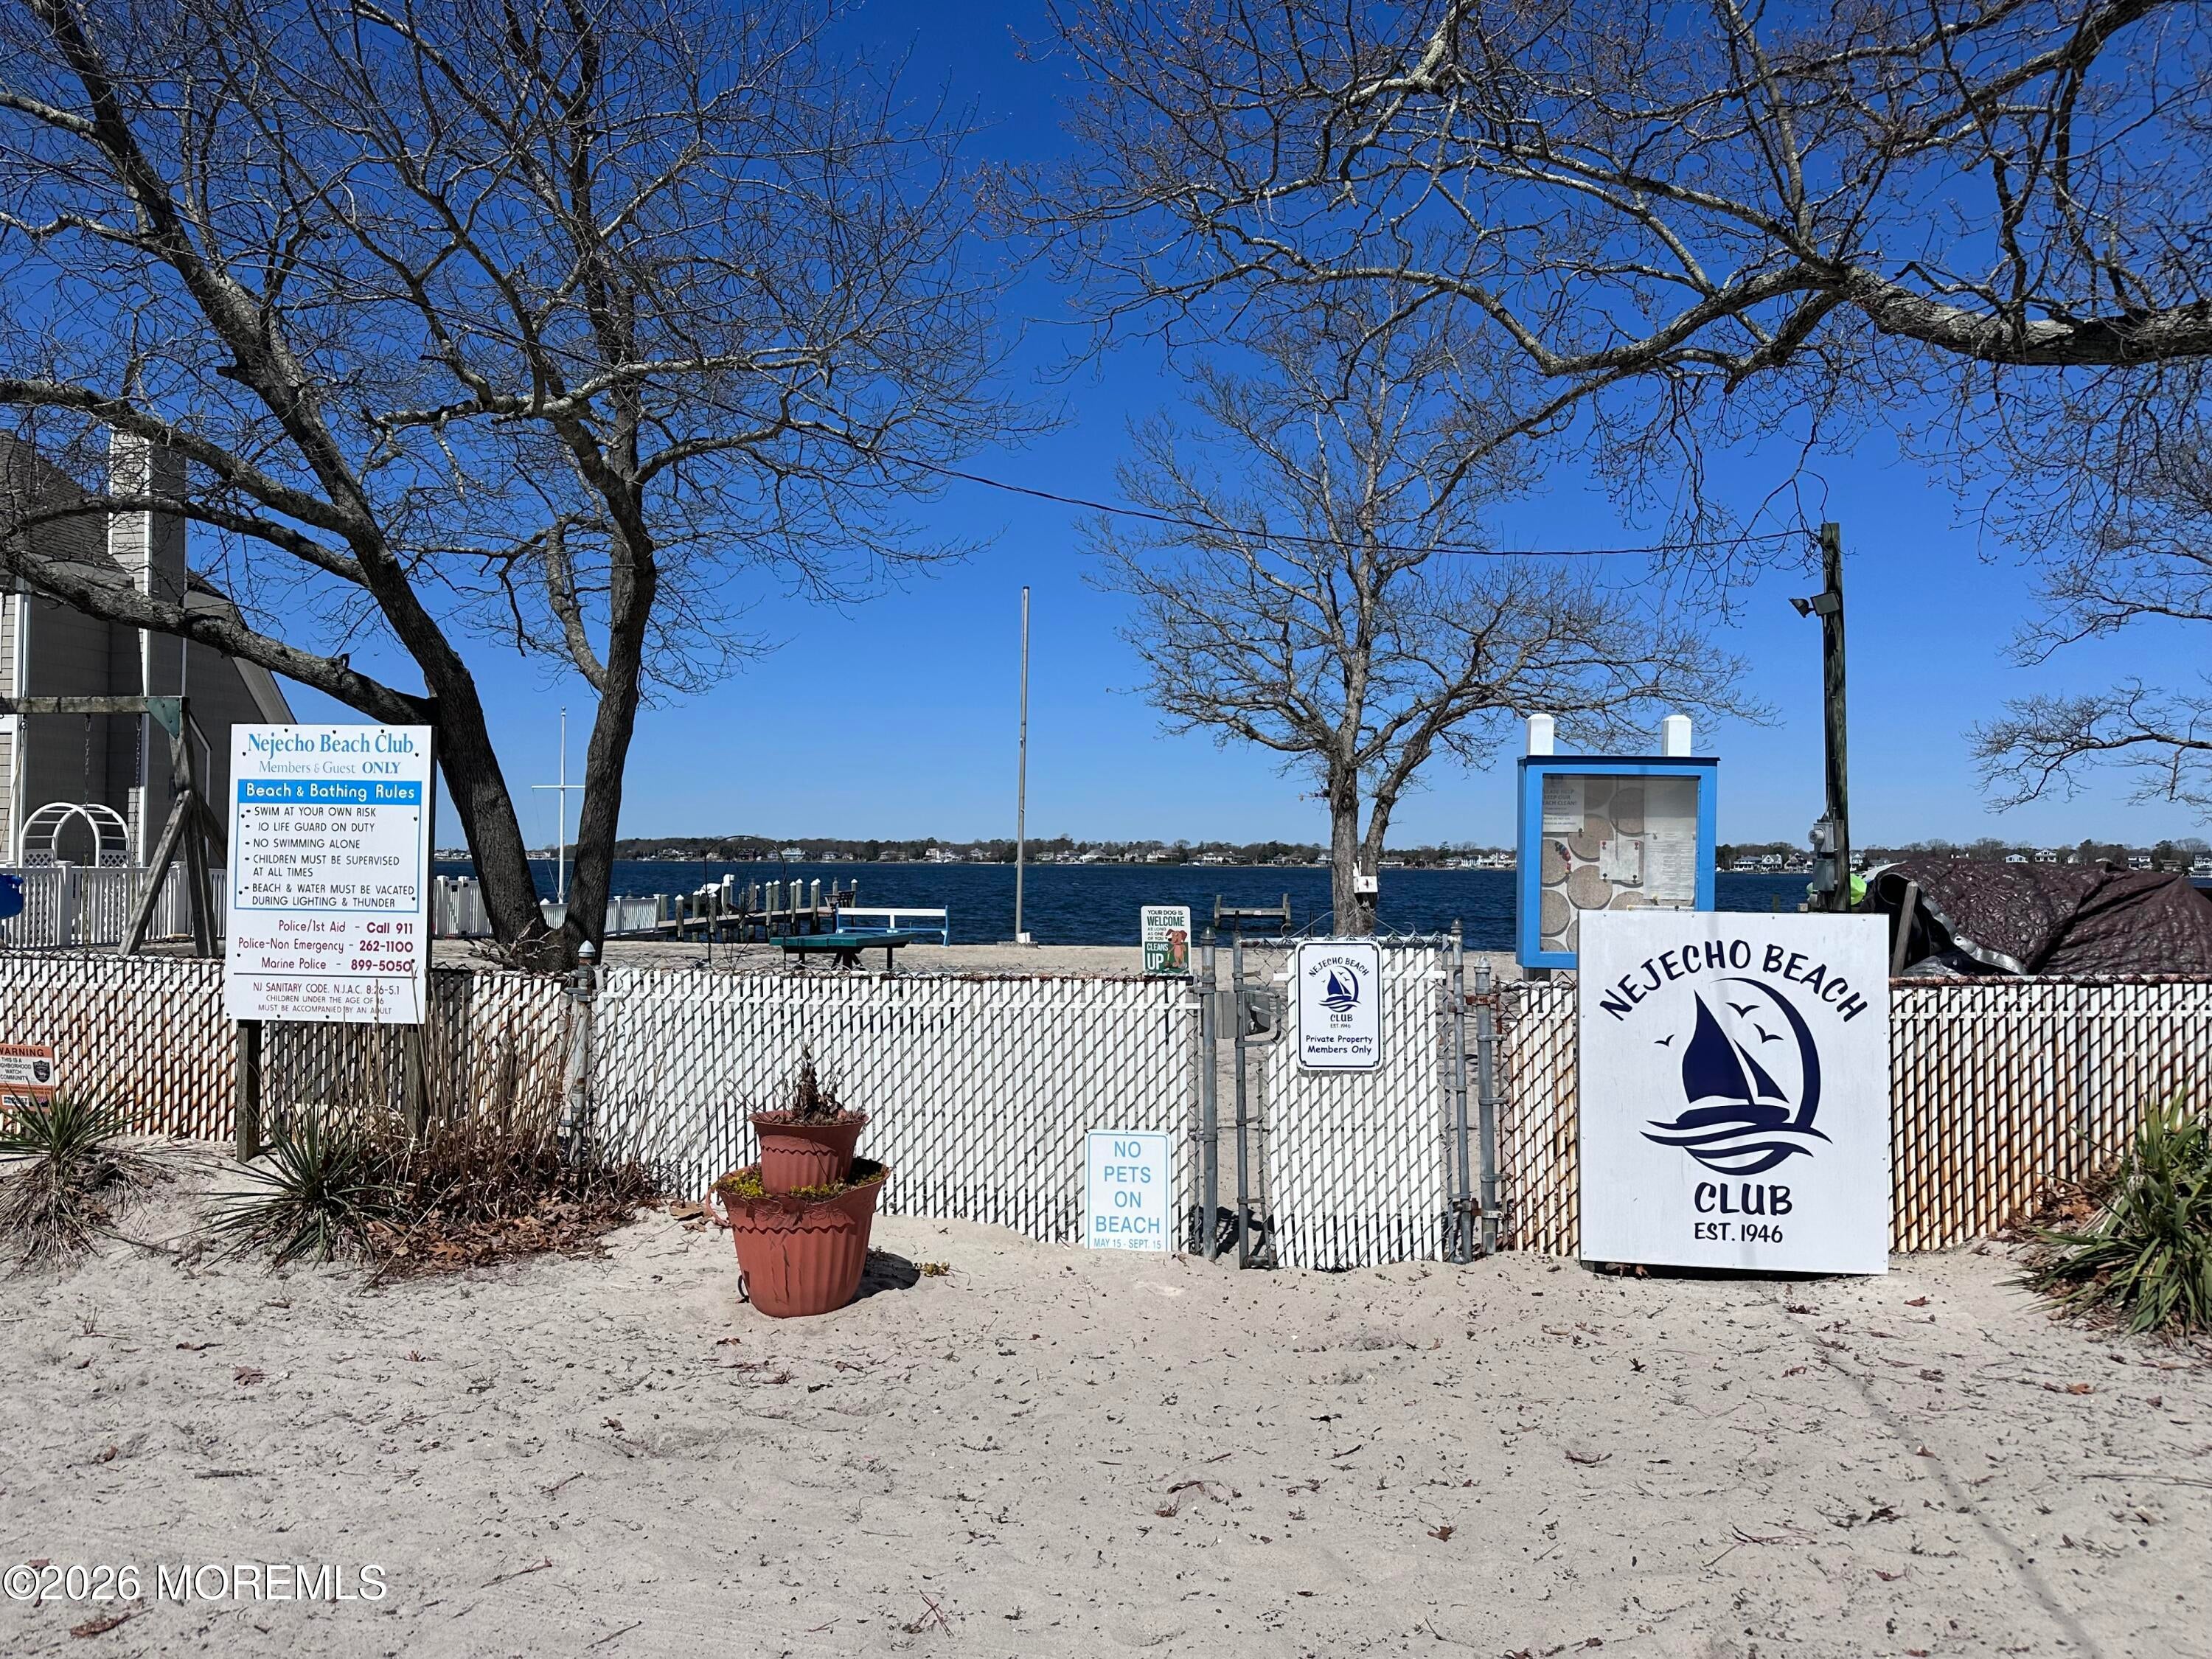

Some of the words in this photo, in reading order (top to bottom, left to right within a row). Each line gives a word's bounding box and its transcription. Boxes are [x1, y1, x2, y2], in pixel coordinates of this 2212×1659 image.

[248, 732, 315, 759] Nejecho
[320, 732, 370, 753] Beach
[375, 733, 414, 753] Club
[260, 760, 310, 773] Members
[314, 762, 319, 773] &
[323, 761, 355, 773] Guest
[362, 762, 401, 773] ONLY
[246, 782, 291, 797] Beach
[296, 787, 304, 797] &
[310, 784, 366, 801] Bathing
[375, 785, 414, 799] Rules
[254, 807, 279, 815] SWIM
[285, 807, 294, 815] AT
[299, 807, 324, 816] YOUR
[328, 807, 351, 816] OWN
[357, 808, 376, 817] RISK
[274, 822, 289, 831] LIFE
[295, 823, 326, 832] GUARD
[332, 823, 346, 832] ON
[352, 823, 375, 832] DUTY
[254, 839, 268, 847] NO
[274, 839, 324, 848] SWIMMING
[330, 840, 360, 848] ALONE
[254, 855, 295, 863] CHILDREN
[301, 855, 326, 864] MUST
[331, 855, 341, 864] BE
[346, 856, 400, 865] SUPERVISED
[253, 867, 263, 876] AT
[268, 868, 282, 876] ALL
[288, 868, 313, 877] TIMES
[252, 883, 281, 892] BEACH
[286, 884, 292, 892] &
[297, 884, 325, 893] WATER
[330, 885, 355, 894] MUST
[361, 886, 370, 894] BE
[375, 886, 414, 895] VACATED
[252, 897, 288, 905] DURING
[293, 897, 336, 906] LIGHTING
[342, 898, 348, 907] &
[353, 898, 394, 907] THUNDER
[279, 919, 324, 932] Police/1st
[330, 922, 345, 932] Aid
[366, 922, 389, 933] Call
[396, 923, 413, 934] 911
[1147, 917, 1184, 926] WELCOME
[238, 937, 289, 949] Police-Non
[295, 939, 344, 953] Emergency
[359, 940, 413, 953] 262-1100
[1147, 943, 1168, 951] CLEANS
[261, 957, 294, 969] Marine
[299, 958, 326, 970] Police
[351, 959, 411, 972] 899-5050
[1147, 953, 1164, 970] UP
[1308, 957, 1343, 977] NEJECHO
[1345, 958, 1369, 975] BEACH
[1599, 939, 1750, 1021] NEJECHO
[1762, 944, 1868, 1023] BEACH
[254, 983, 262, 991] NJ
[266, 984, 302, 992] SANITARY
[334, 985, 362, 994] N.J.A.C.
[1338, 1036, 1372, 1044] Property
[1352, 1046, 1371, 1055] Only
[1115, 1141, 1141, 1158] NO
[1105, 1166, 1151, 1183] PETS
[1115, 1191, 1141, 1208] ON
[1695, 1182, 1792, 1216] CLUB
[1096, 1216, 1159, 1233] BEACH
[1695, 1223, 1735, 1242] EST.
[1741, 1225, 1783, 1242] 1946
[1094, 1239, 1110, 1248] MAY
[1113, 1239, 1121, 1248] 15
[1153, 1240, 1161, 1249] 15
